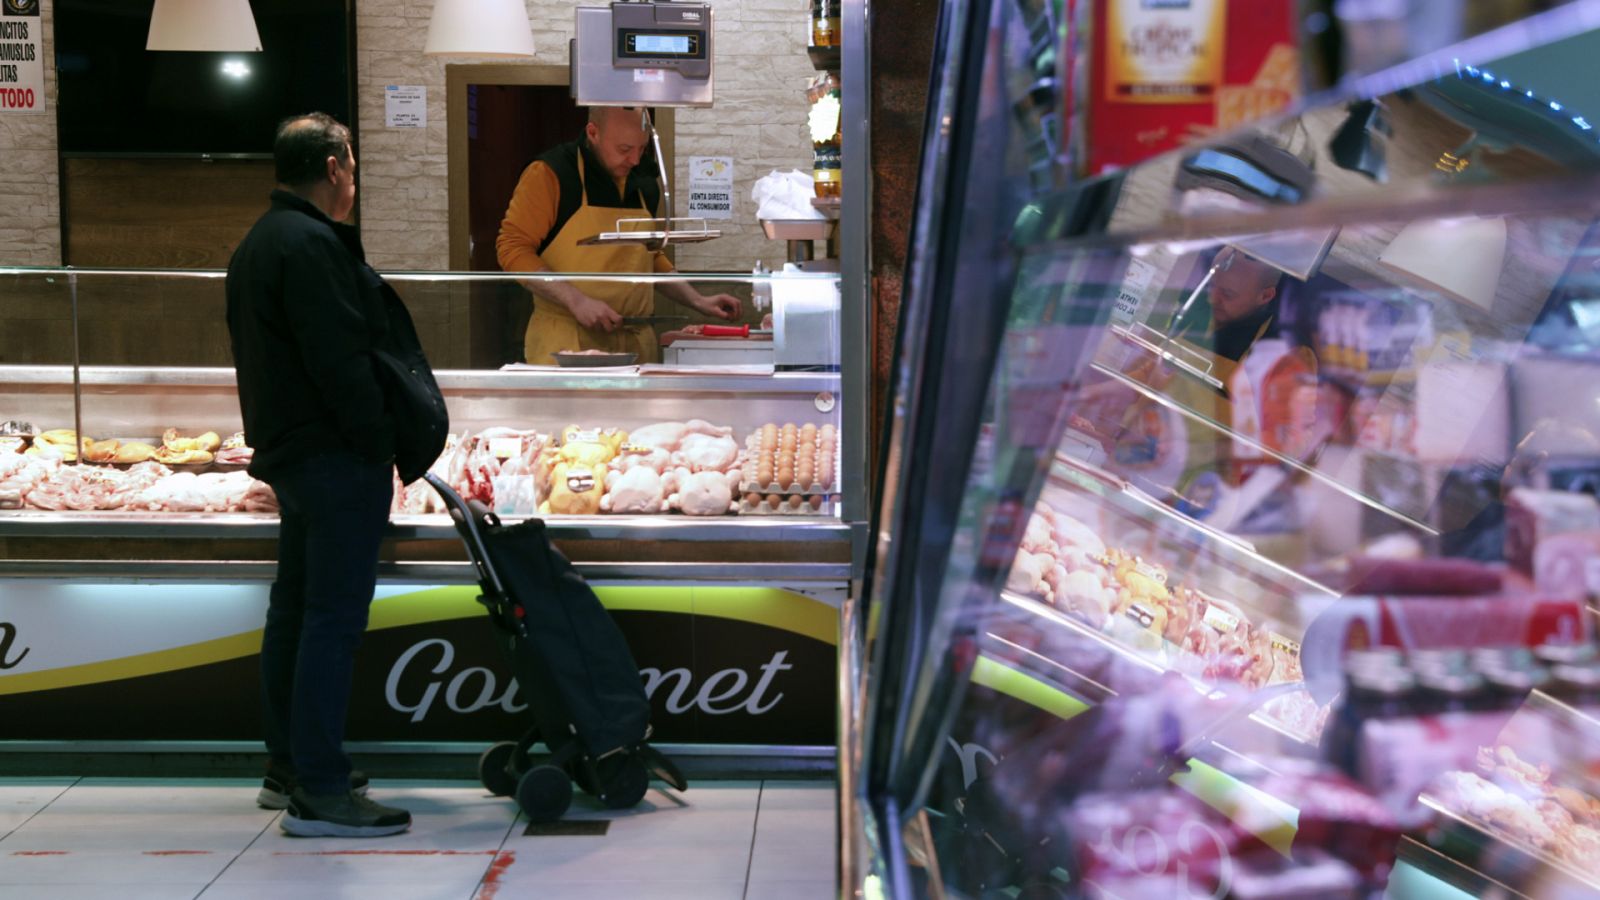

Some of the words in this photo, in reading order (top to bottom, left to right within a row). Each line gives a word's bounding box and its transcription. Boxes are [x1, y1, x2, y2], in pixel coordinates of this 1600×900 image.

[0, 88, 34, 108] TODO
[690, 192, 707, 201] VENTA
[708, 193, 729, 201] DIRECTA
[689, 202, 696, 211] AL
[697, 202, 731, 211] CONSUMIDOR
[385, 638, 793, 723] Gomet
